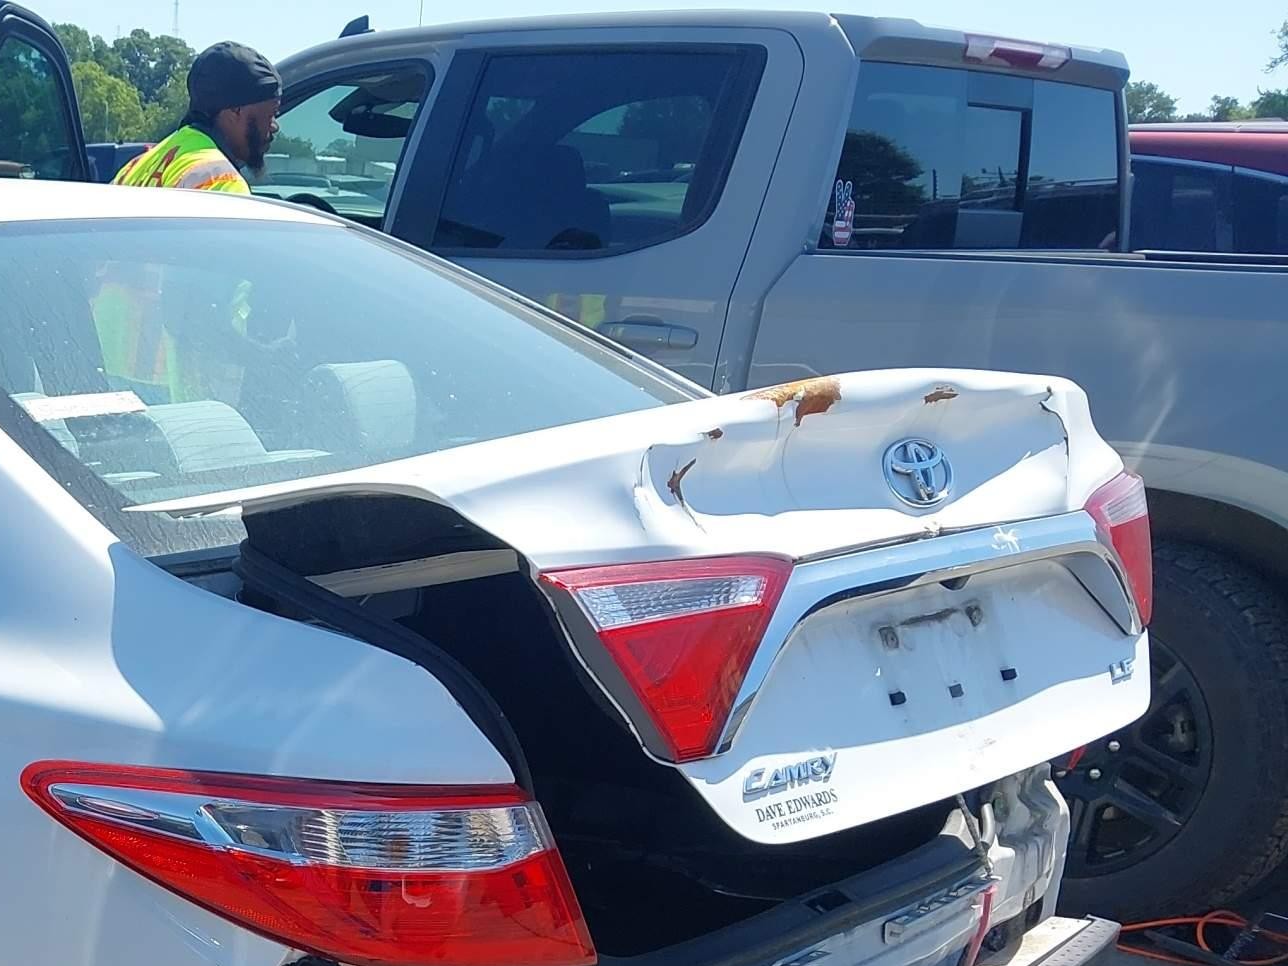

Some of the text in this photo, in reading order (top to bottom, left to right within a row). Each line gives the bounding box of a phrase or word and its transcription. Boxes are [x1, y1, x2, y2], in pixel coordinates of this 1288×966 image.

[1109, 658, 1135, 685] LE
[743, 752, 838, 802] CAMRY
[755, 788, 838, 823] DAVE EDWARDS
